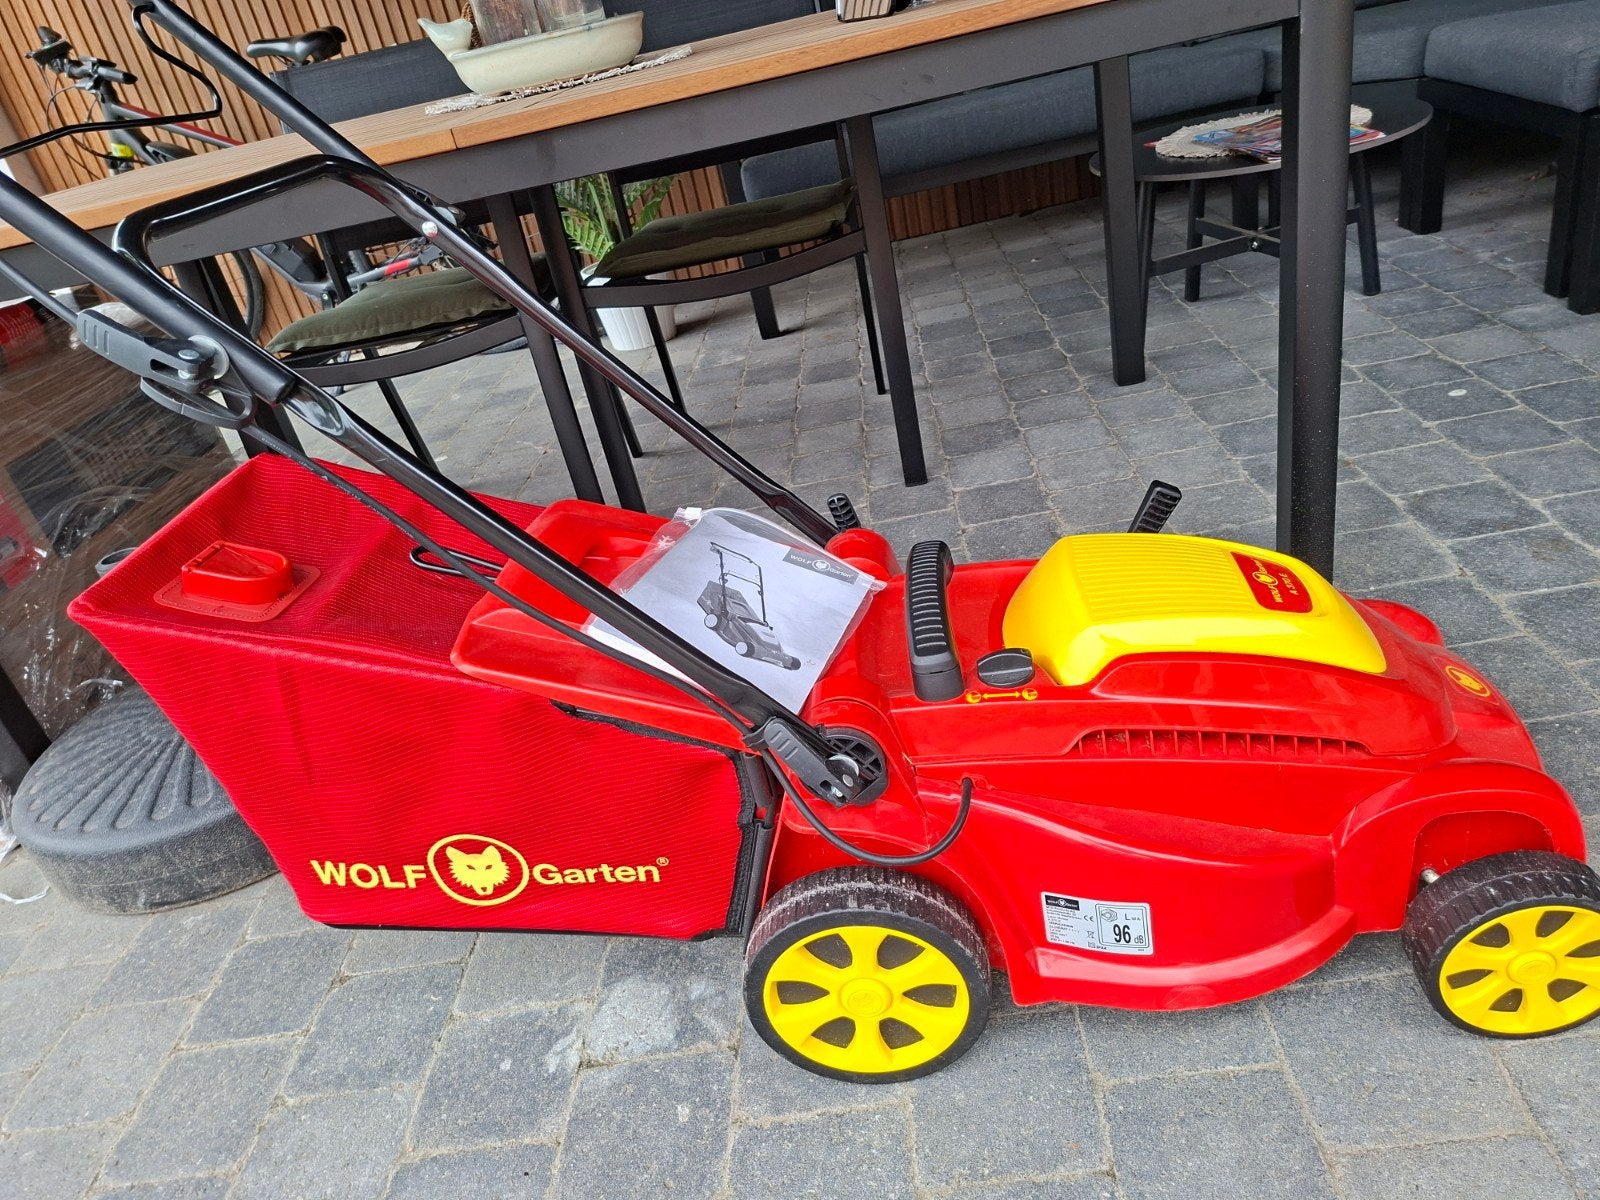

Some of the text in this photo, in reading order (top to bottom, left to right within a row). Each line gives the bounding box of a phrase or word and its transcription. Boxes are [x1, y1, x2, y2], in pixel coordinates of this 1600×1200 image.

[790, 554, 812, 564] WOLF
[310, 859, 428, 889] WOLF
[1112, 923, 1132, 944] 96
[1133, 934, 1144, 945] dB
